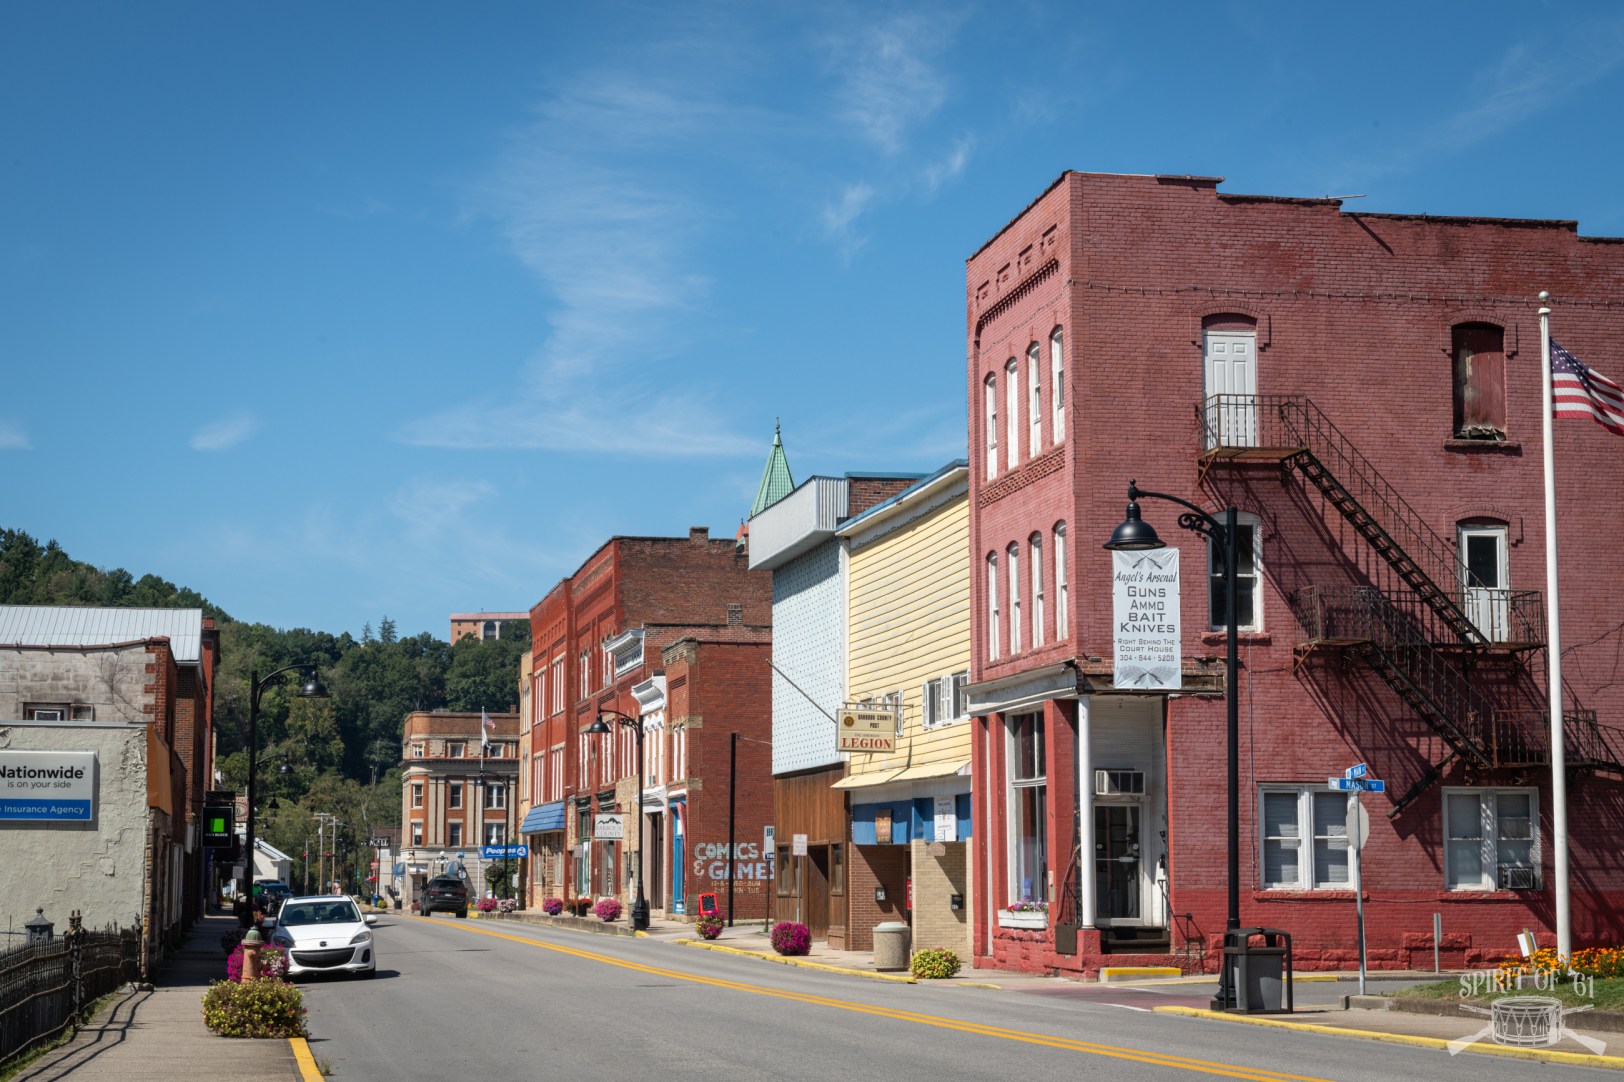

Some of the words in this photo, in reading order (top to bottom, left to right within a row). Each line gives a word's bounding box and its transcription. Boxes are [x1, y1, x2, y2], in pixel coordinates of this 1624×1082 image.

[1115, 571, 1144, 585] Angel's
[1146, 571, 1177, 583] Arsenal
[1127, 586, 1166, 597] GUNS
[1130, 600, 1165, 611] AMMO
[1128, 612, 1166, 622] BAIT
[1120, 622, 1176, 633] KNIVES
[841, 737, 892, 749] LEGION
[0, 765, 84, 779] Nationwide
[7, 780, 14, 788] is
[31, 781, 50, 790] your
[53, 781, 72, 789] side
[1345, 780, 1369, 790] MASON
[4, 805, 48, 813] Insurance
[50, 805, 84, 815] Agency
[486, 847, 517, 855] Peopes
[694, 842, 759, 860] COMICS
[693, 860, 705, 876] &
